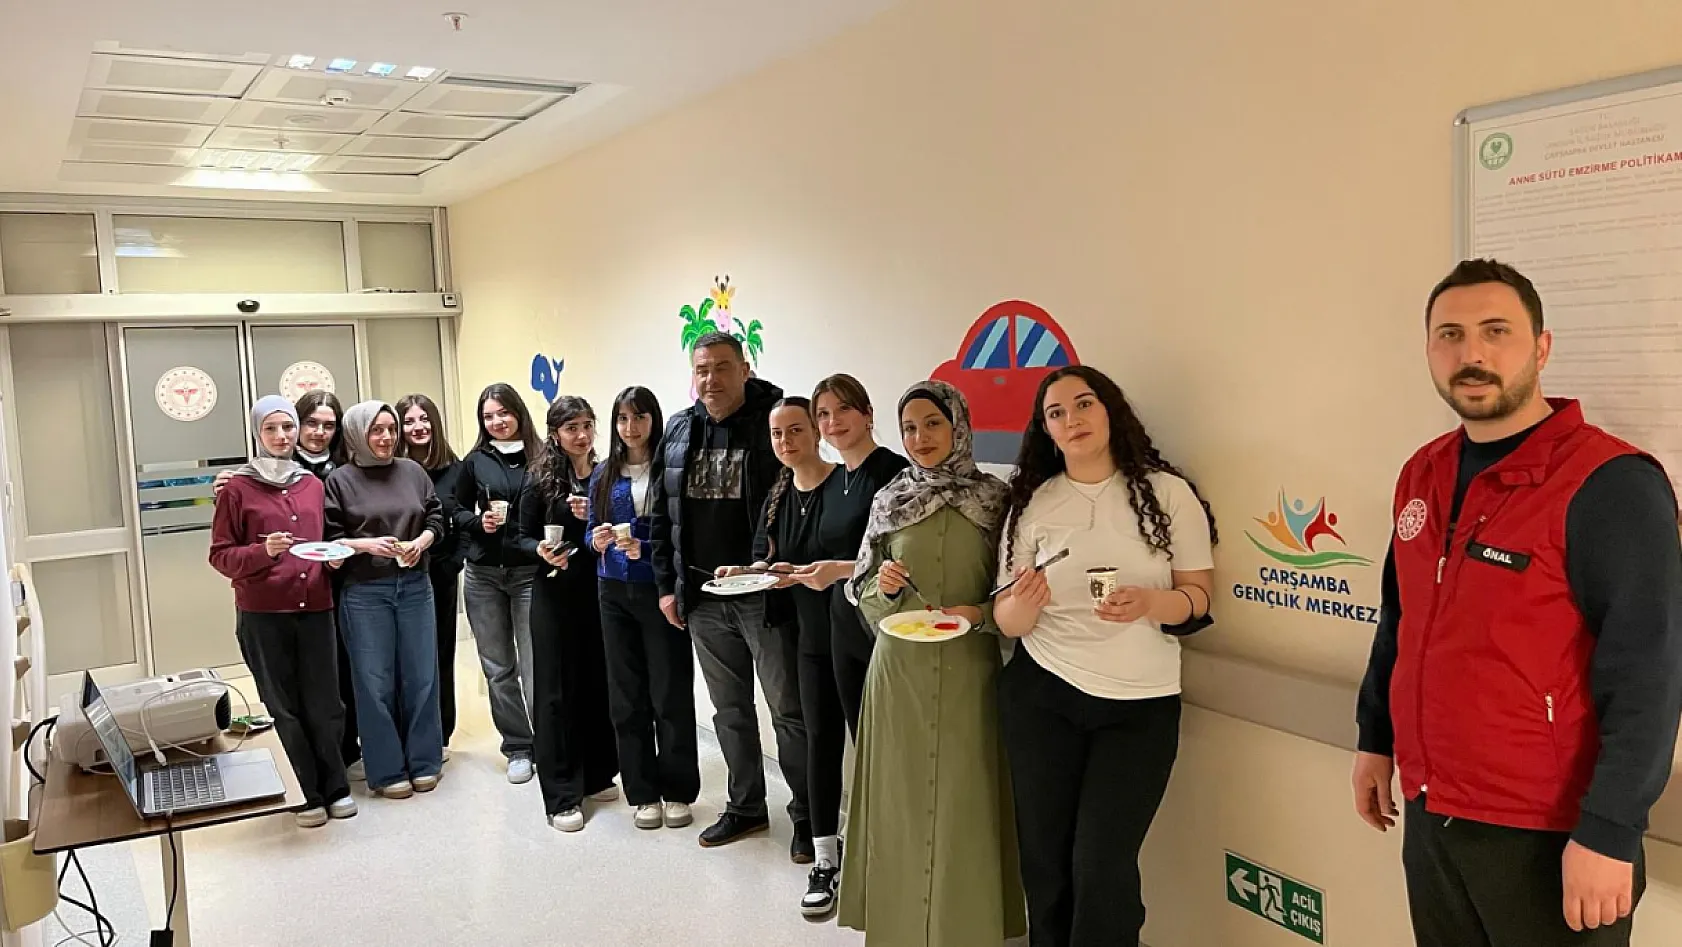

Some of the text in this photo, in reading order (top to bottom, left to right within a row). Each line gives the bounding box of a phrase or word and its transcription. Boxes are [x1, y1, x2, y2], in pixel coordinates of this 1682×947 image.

[1508, 174, 1537, 185] ANNE
[1538, 169, 1566, 181] SÜTÜ
[1568, 161, 1618, 177] EMZİRME
[1260, 567, 1350, 595] ÇARŞAMBA
[1233, 584, 1301, 609] GENÇLİK
[1292, 891, 1320, 915] ACİL
[1290, 909, 1320, 936] ÇIKIŞ
